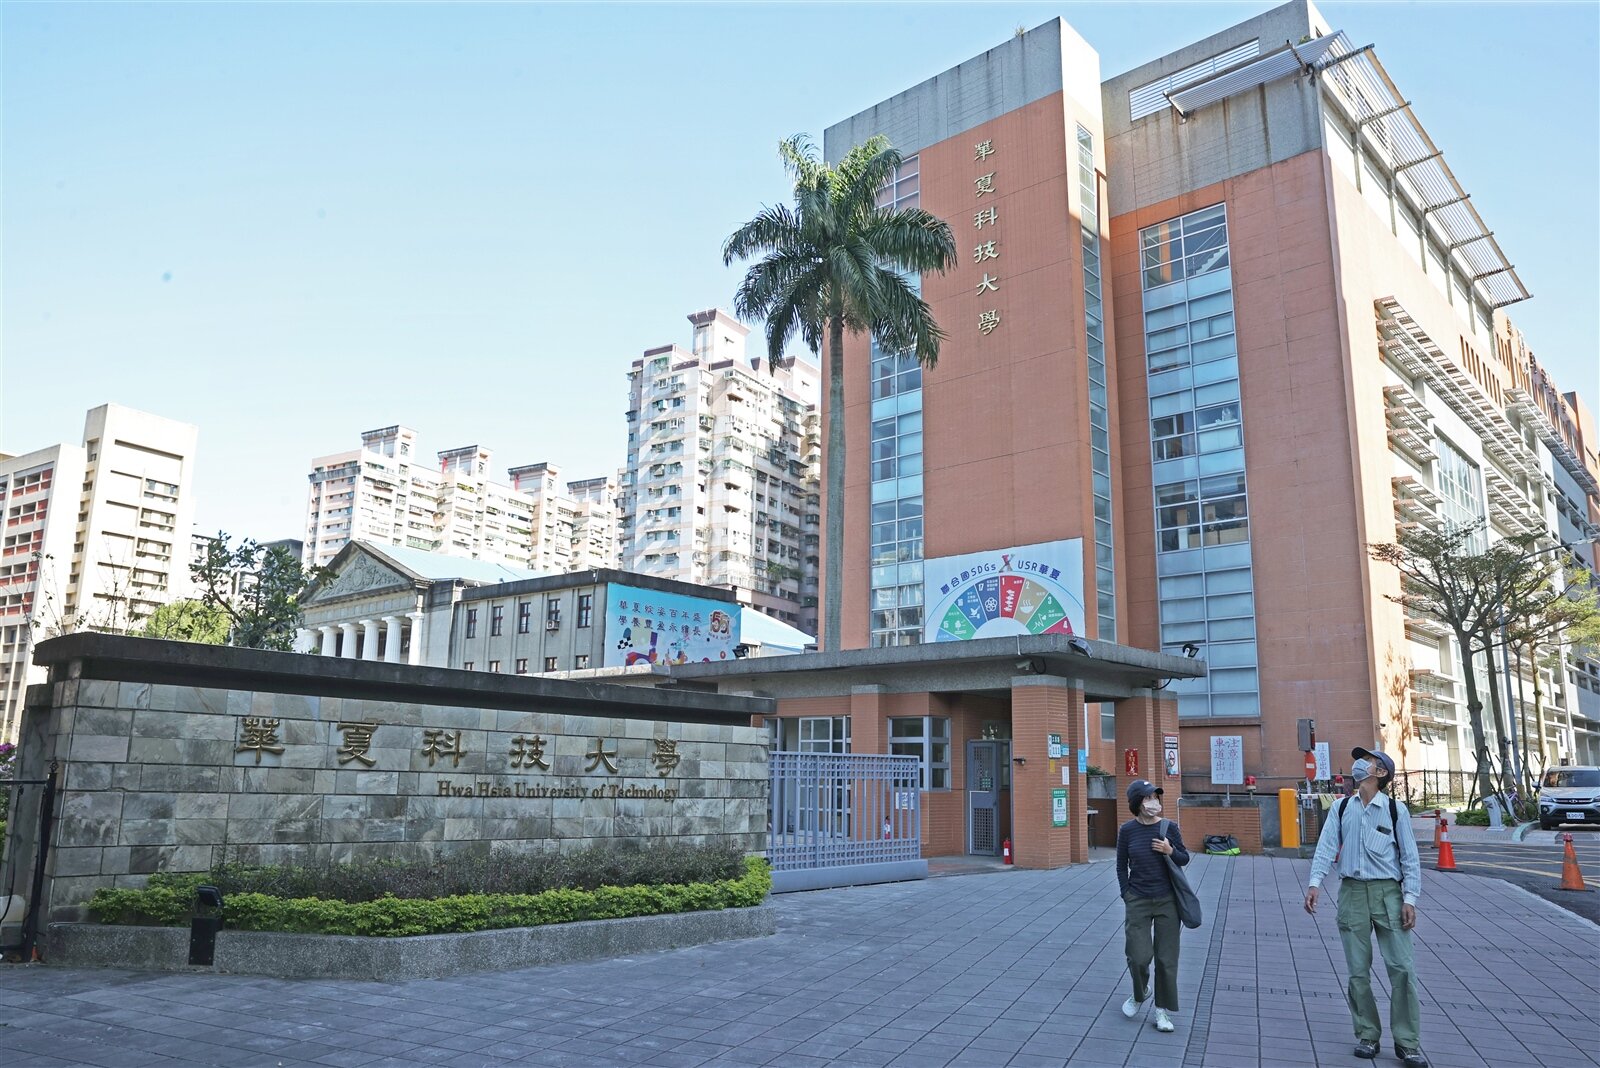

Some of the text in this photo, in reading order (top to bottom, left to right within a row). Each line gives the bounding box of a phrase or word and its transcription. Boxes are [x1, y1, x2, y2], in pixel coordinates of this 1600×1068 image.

[974, 139, 1000, 335] 華夏科技大學
[236, 717, 681, 776] 華夏科技大學
[1214, 737, 1226, 780] 車道出口
[437, 780, 679, 802] Hwa Hsia University of Technology
